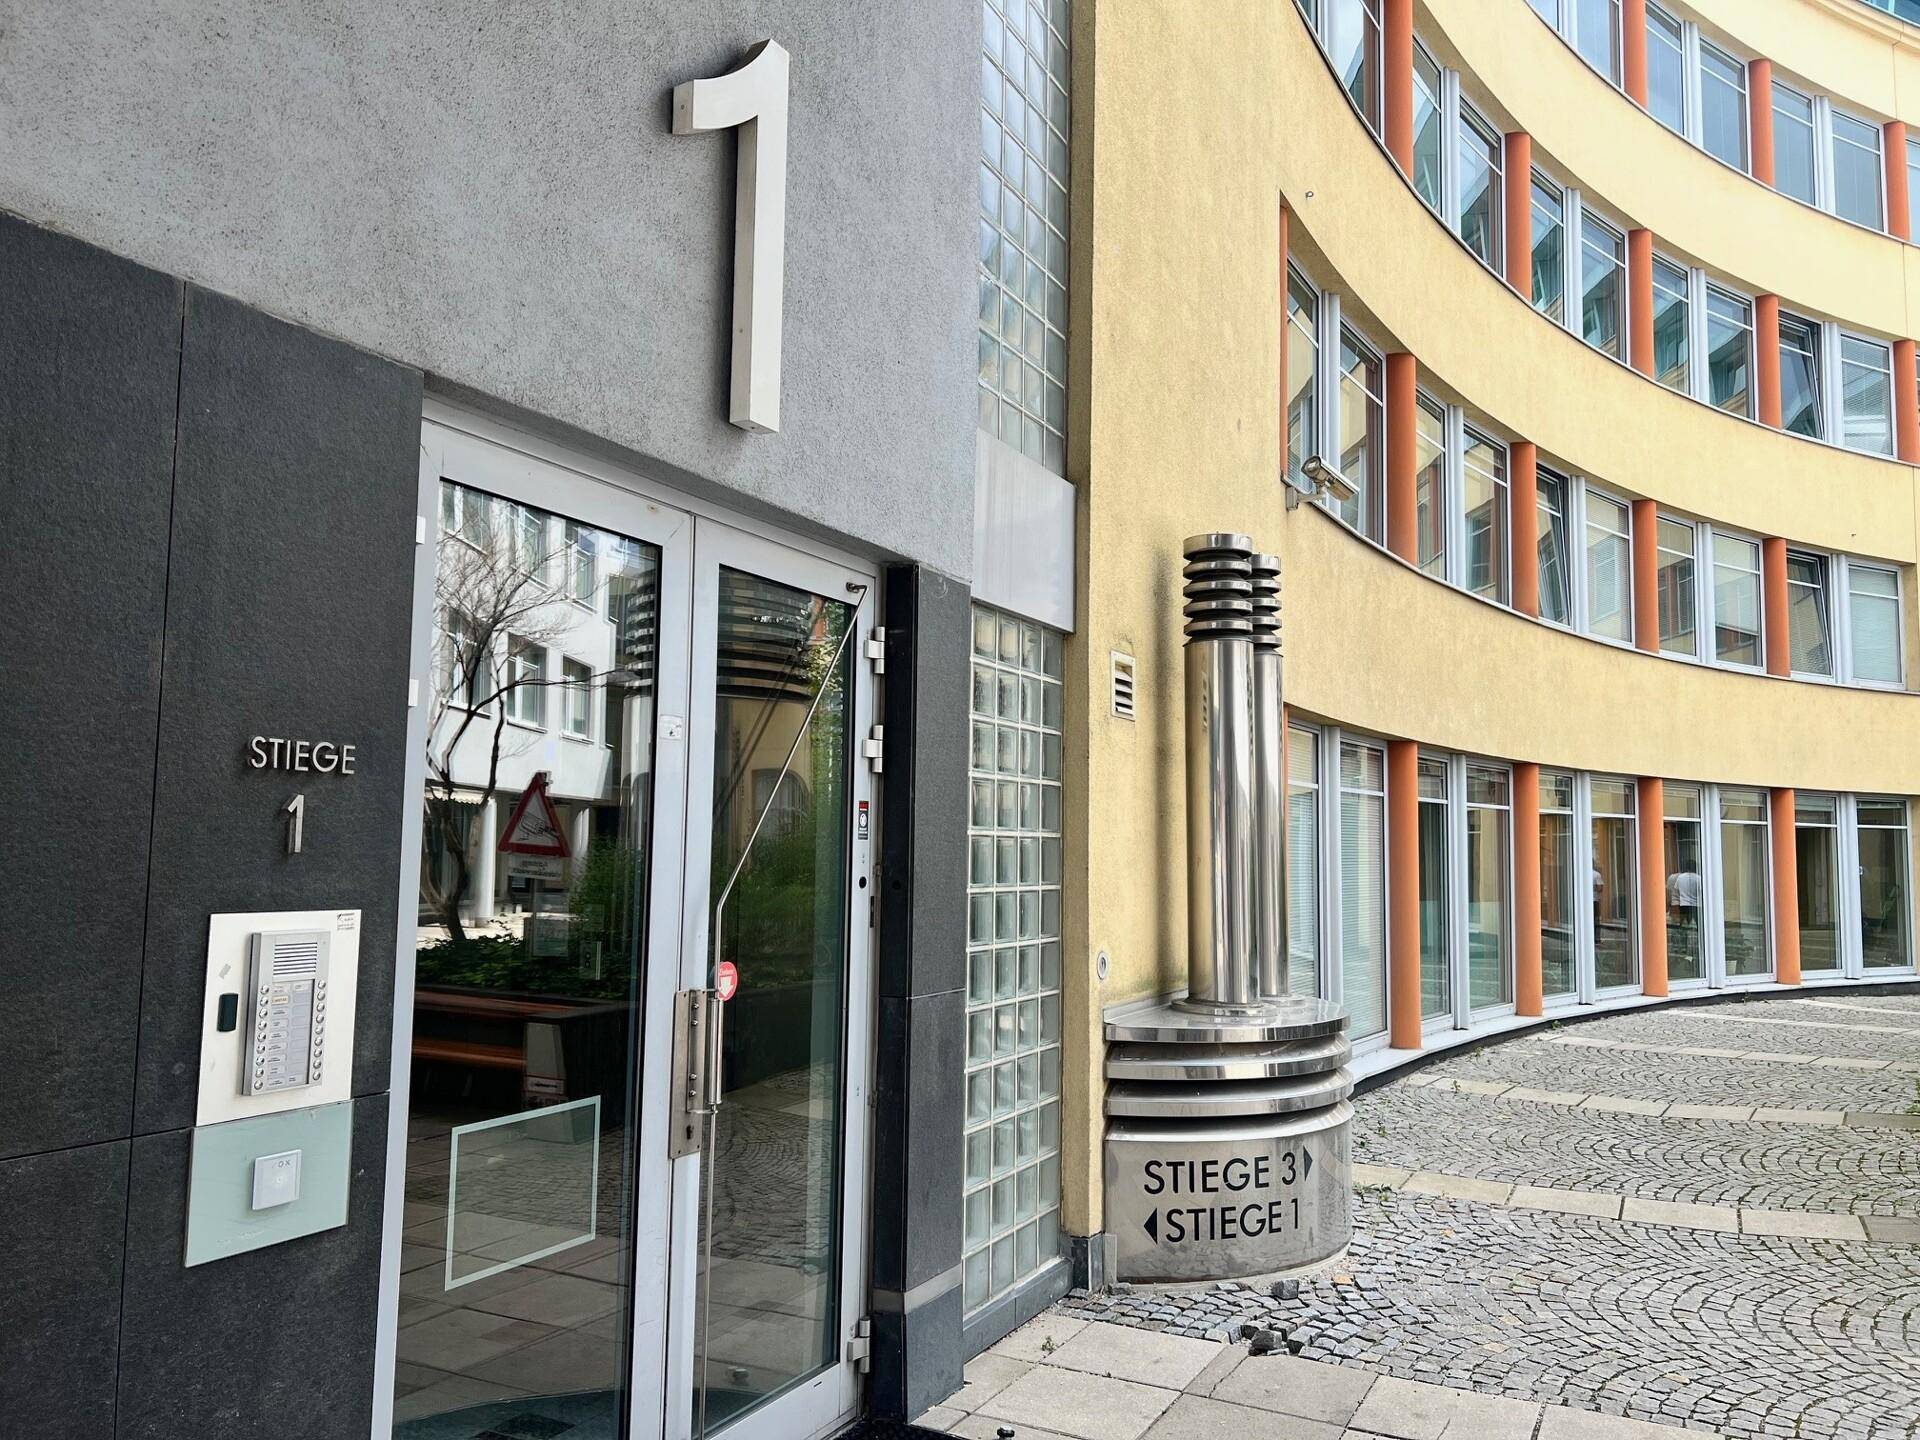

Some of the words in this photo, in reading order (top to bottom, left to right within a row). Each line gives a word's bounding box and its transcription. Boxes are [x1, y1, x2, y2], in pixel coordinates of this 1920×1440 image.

[673, 38, 790, 433] 1
[250, 735, 356, 775] STIEGE
[284, 794, 305, 854] 1
[1143, 1156, 1270, 1195] STIEGE
[1281, 1151, 1297, 1186] 3
[1165, 1200, 1282, 1243] STIEGE
[1290, 1197, 1299, 1230] 1
